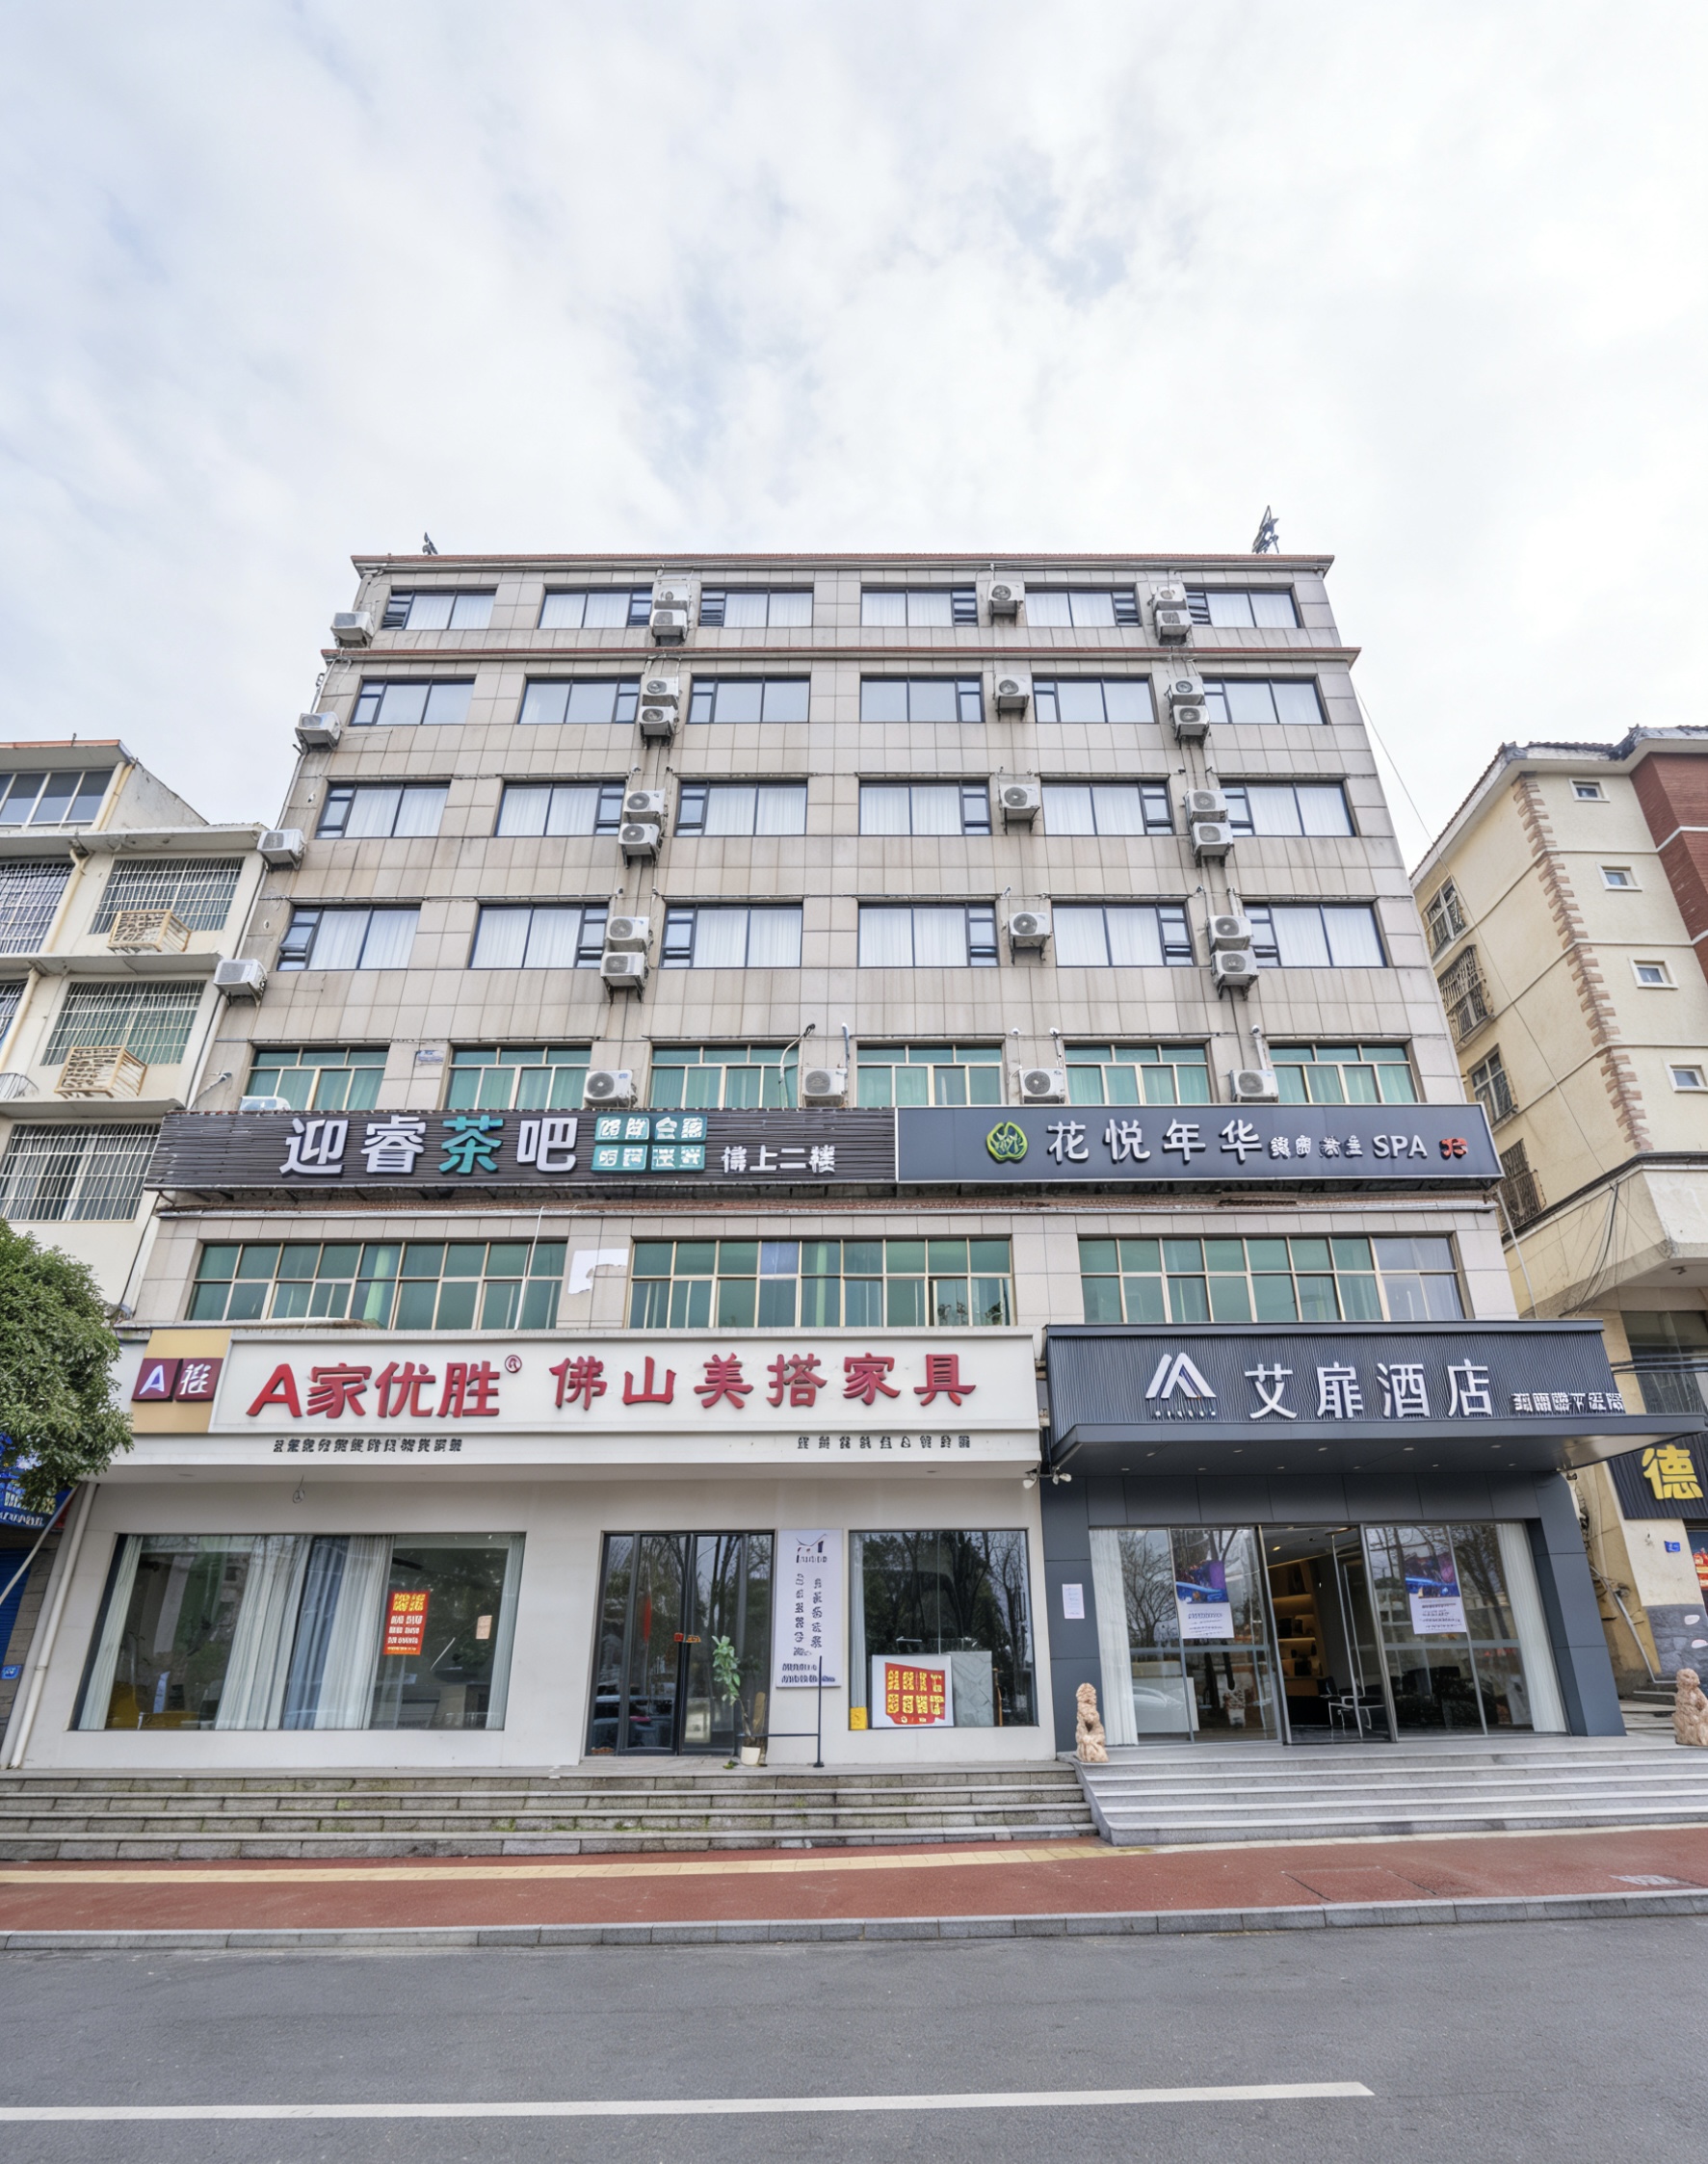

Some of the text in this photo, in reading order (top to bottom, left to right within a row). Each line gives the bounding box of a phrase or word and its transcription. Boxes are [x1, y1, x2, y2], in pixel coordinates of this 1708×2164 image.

[279, 1115, 578, 1176] 迎睿茶吧
[1047, 1119, 1263, 1164] 花悦年华
[1373, 1134, 1429, 1157] SPA
[246, 1360, 501, 1419] A家优胜
[548, 1352, 977, 1411] 佛山美搭家具
[1245, 1359, 1493, 1420] 艾扉酒店
[1641, 1443, 1704, 1500] 德
